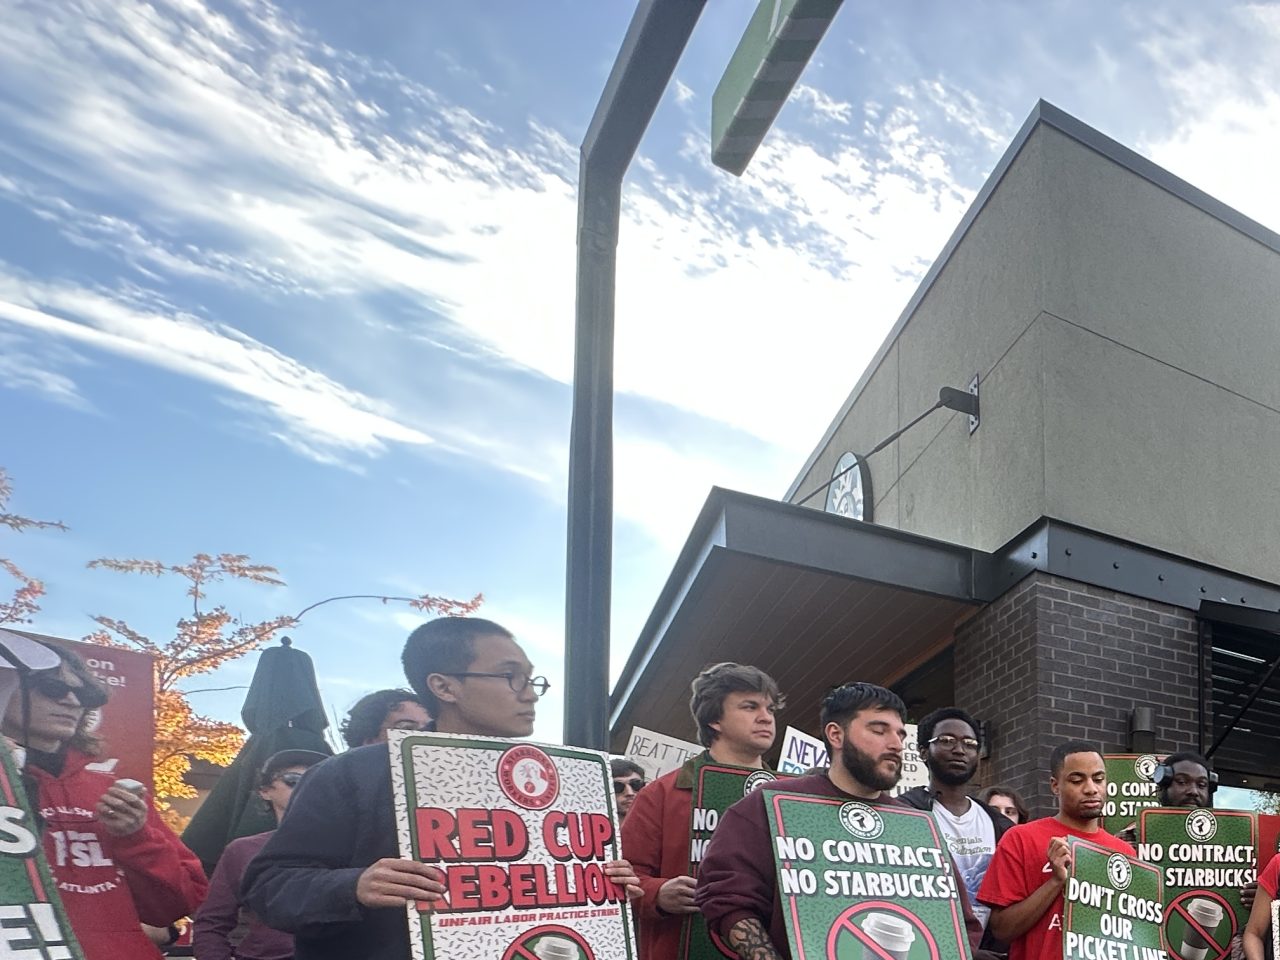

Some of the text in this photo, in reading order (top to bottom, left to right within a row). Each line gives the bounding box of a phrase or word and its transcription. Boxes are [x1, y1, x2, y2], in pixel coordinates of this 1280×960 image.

[629, 735, 673, 760] BEAT
[693, 808, 718, 831] NO
[415, 806, 614, 863] RED CUP
[775, 836, 950, 874] NO CONTRACT,
[1138, 843, 1164, 862] NO
[1168, 844, 1257, 866] CONTRACT,
[780, 868, 958, 900] NO STARBUCKS!
[1165, 867, 1257, 887] STARBUCKS!
[1068, 877, 1164, 924] DON'T CROSS
[439, 907, 620, 928] UNFAIR LABOR PRACTICE STRIKE
[1100, 914, 1134, 941] OUR
